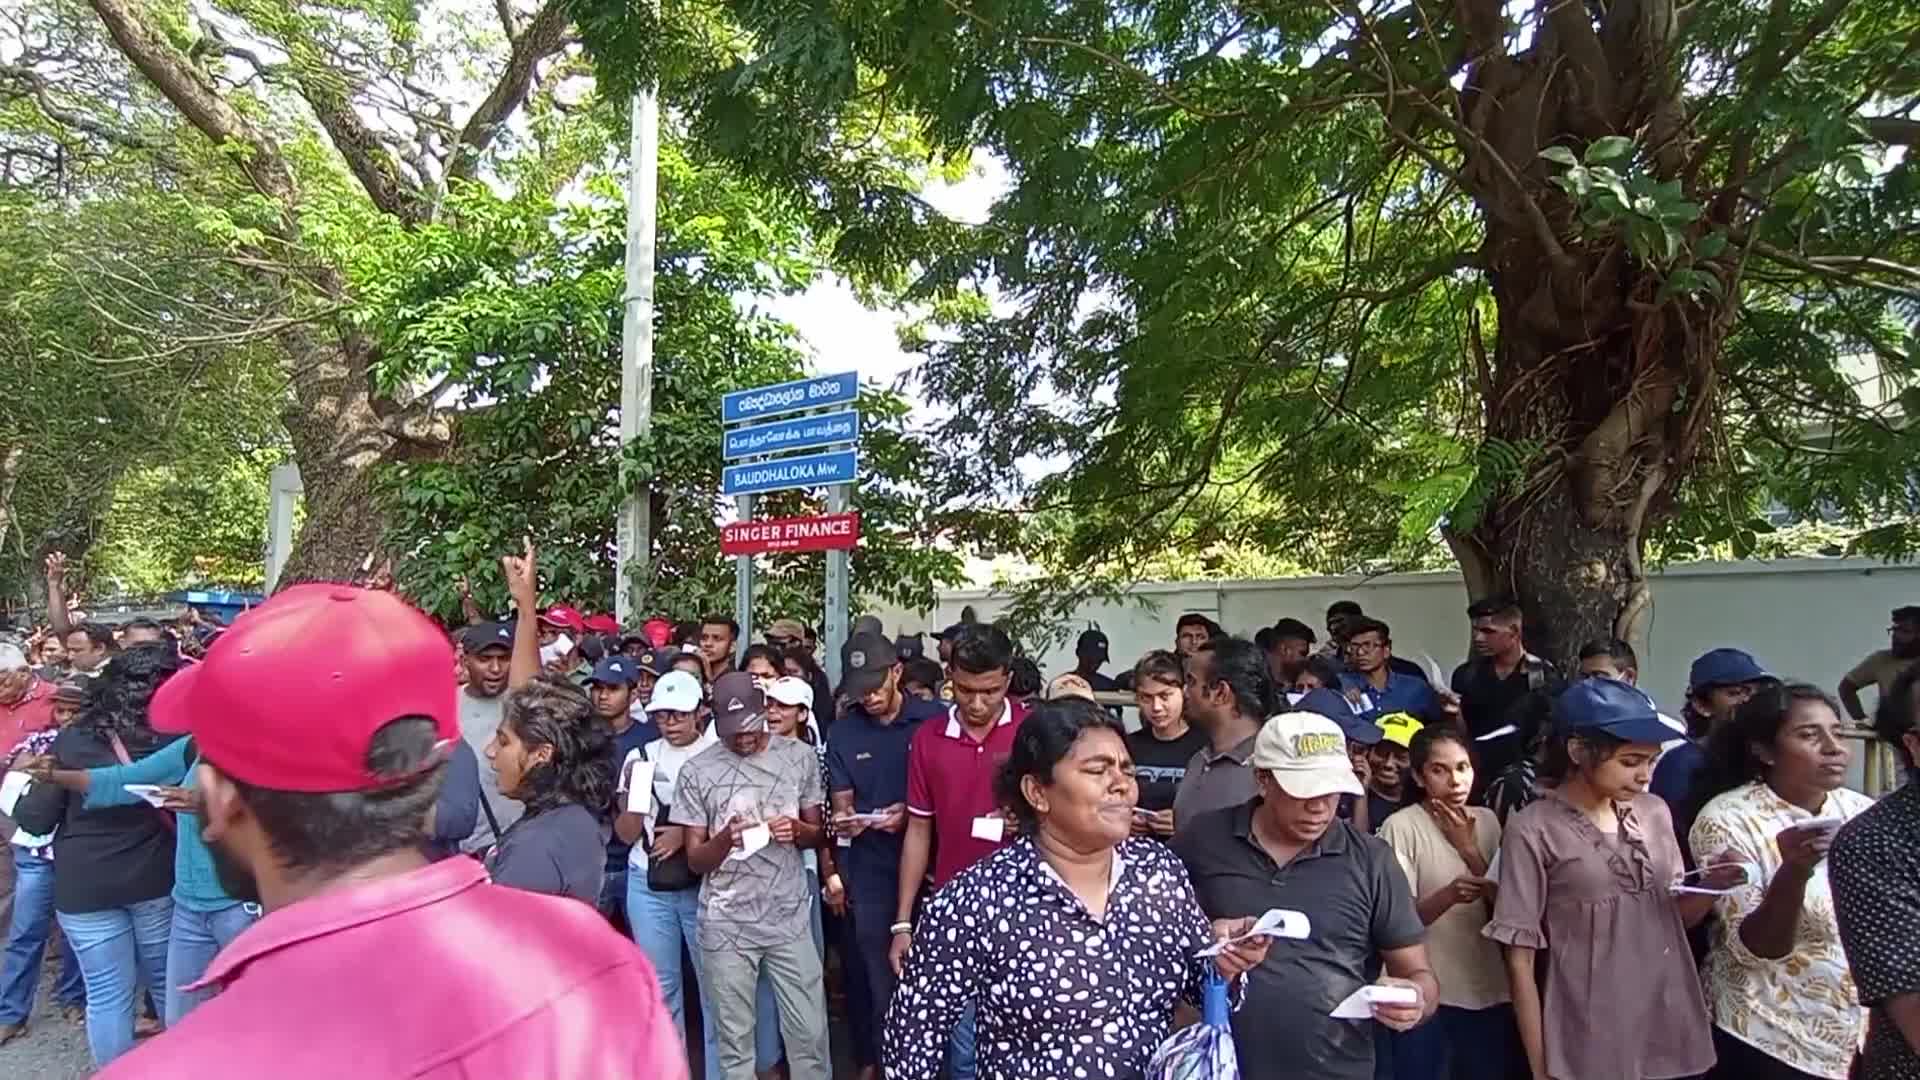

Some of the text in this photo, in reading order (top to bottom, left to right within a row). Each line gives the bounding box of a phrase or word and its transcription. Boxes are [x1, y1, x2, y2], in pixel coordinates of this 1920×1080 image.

[808, 381, 841, 398] මාවත
[734, 462, 841, 487] BAUDDHALOKA Mw.
[725, 520, 851, 542] SINGER FINANCE
